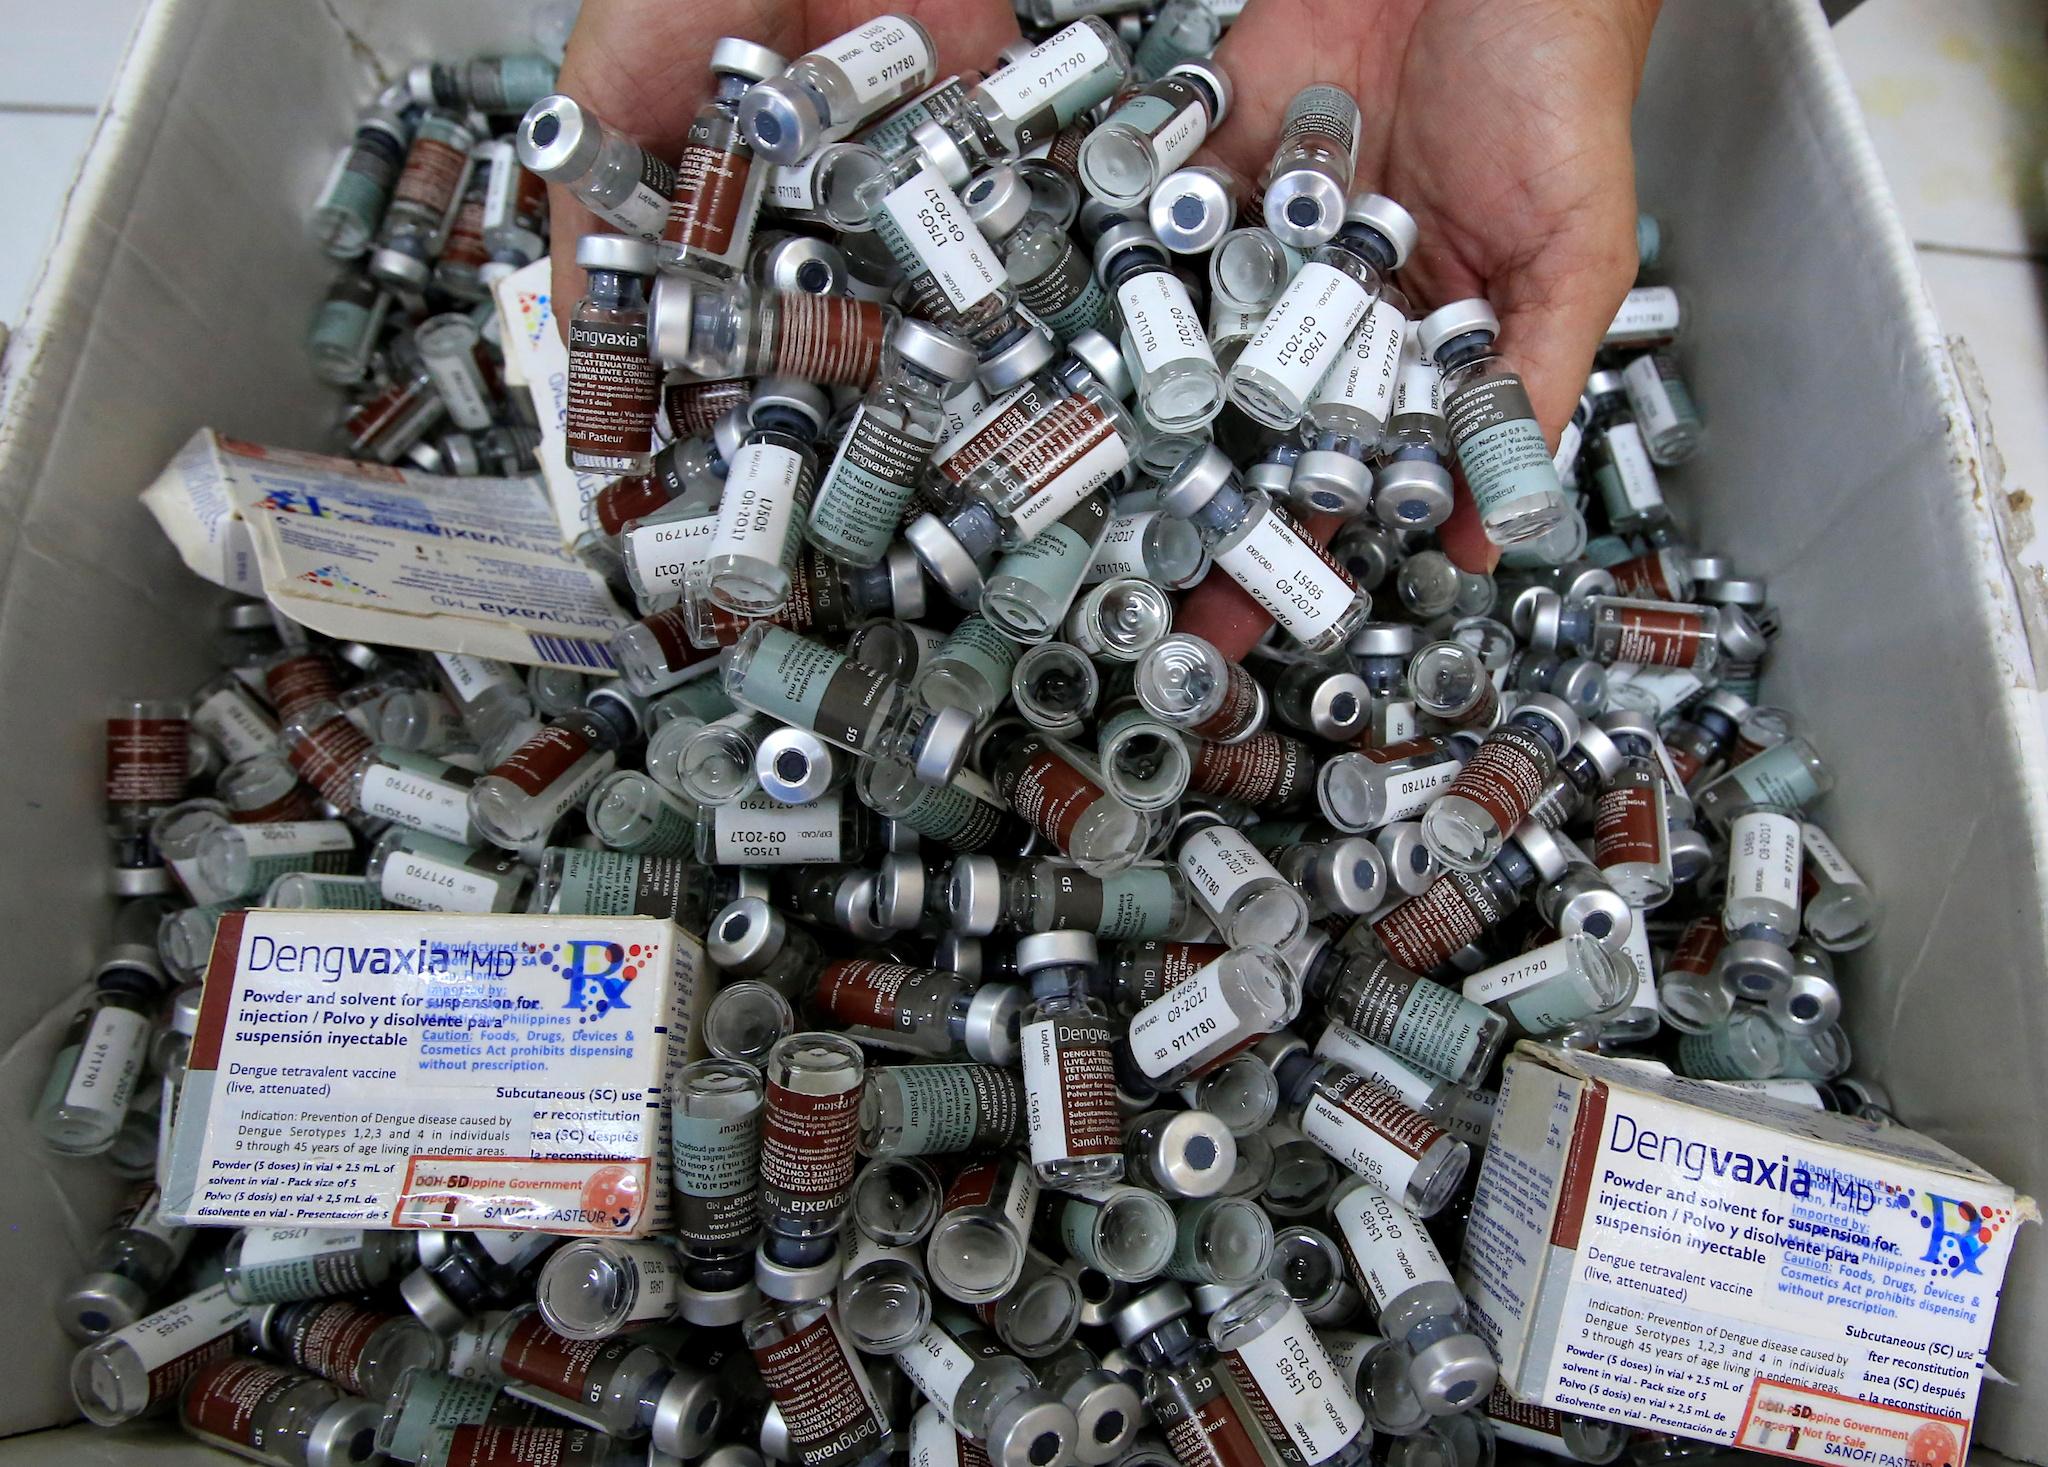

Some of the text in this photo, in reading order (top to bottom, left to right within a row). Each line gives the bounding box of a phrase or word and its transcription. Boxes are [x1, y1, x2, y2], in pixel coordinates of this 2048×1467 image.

[870, 28, 906, 54] 09-2017
[882, 55, 916, 81] 971780
[1018, 52, 1088, 101] 061 971790
[1022, 128, 1032, 144] 5D
[1164, 123, 1191, 152] 971790
[916, 212, 948, 248] L7505
[924, 188, 966, 243] 09-2017
[1133, 310, 1158, 353] 971790
[1169, 307, 1195, 349] 09-2017
[1253, 299, 1291, 348] 971790
[1357, 311, 1378, 360] 09-2017
[1276, 315, 1317, 367] 09-2017
[1299, 330, 1328, 368] L7505
[1377, 329, 1400, 399] 323 971780
[1461, 378, 1519, 401] RECONSTITUTION
[589, 431, 623, 443] Pasteur
[888, 434, 902, 445] FOR
[731, 489, 756, 542] 09-2017
[754, 497, 773, 532] L7505
[1089, 501, 1104, 518] 5D
[655, 525, 710, 544] 971790
[841, 529, 874, 547] Pasteur
[1245, 543, 1321, 621] EXP/CAD: 09-2017
[1294, 569, 1325, 602] L5485
[1251, 588, 1294, 628] 971780
[846, 726, 858, 743] 5D
[385, 776, 435, 801] 971790
[1401, 777, 1438, 796] 971780
[1634, 771, 1651, 782] 5D
[556, 777, 592, 816] 971780
[730, 830, 787, 843] 09-2017
[405, 864, 455, 889] 971790
[1061, 876, 1073, 893] 5D
[1194, 864, 1220, 896] 971780
[472, 950, 514, 977] MD
[1501, 959, 1548, 988] 971790
[243, 989, 540, 1011] Powder and solvent for suspension for
[1167, 986, 1209, 1024] 09-2017
[239, 1009, 503, 1031] injection Polvo y disolvente para
[503, 1014, 571, 1026] Philippines
[236, 1031, 407, 1048] suspensión inyectable
[422, 1030, 634, 1043] Caution: Foods, Drugs, Devices &
[1154, 1017, 1217, 1061] 323 971780
[1448, 1024, 1471, 1057] Pasteur
[83, 1043, 110, 1088] 971790
[419, 1061, 549, 1072] without prescription.
[421, 1045, 634, 1059] Cosmetics Act prohibits dispensing
[1063, 1050, 1096, 1058] DENGUE
[229, 1063, 397, 1079] Dengue tetravalent vaccine
[1370, 1069, 1405, 1100] L7505
[226, 1081, 331, 1098] (live, attenuated)
[496, 1087, 643, 1102] Subcutaneous (SC) use
[241, 1110, 512, 1128] Indication: Prevention of Dengue disease caused by
[551, 1110, 640, 1122] reconstitution
[1030, 1091, 1041, 1132] L5485
[238, 1126, 510, 1141] Dengue Serotypes 1,2,3 and 4 in individuals
[1072, 1135, 1102, 1148] Sanofi
[1351, 1147, 1384, 1176] L5485
[1832, 1178, 1874, 1213] MD
[1371, 1194, 1404, 1240] 09-2017
[1604, 1170, 1898, 1253] Powder and solvent for suspension for
[1360, 1211, 1380, 1243] L5485
[1595, 1212, 1767, 1265] suspensión inyectable
[1599, 1191, 1860, 1265] injection Polvo y disolvente para
[1584, 1266, 1688, 1303] (live, attenuated)
[1588, 1246, 1753, 1297] Dengue tetravalent vaccine
[767, 1325, 829, 1363] Sanofi Pasteur
[1845, 1325, 1954, 1360] Subcutaneous (SC)
[1284, 1336, 1323, 1389] 09-2017
[1566, 1344, 1744, 1394] Powder (5 doses) in vial 2.5 mL of
[1892, 1358, 1970, 1379] reconstitution
[1194, 1376, 1213, 1394] 5D
[1276, 1360, 1305, 1396] L5485
[1922, 1383, 1966, 1400] después
[1802, 1424, 1866, 1449] Not for Sale
[1843, 1418, 1909, 1441] Government
